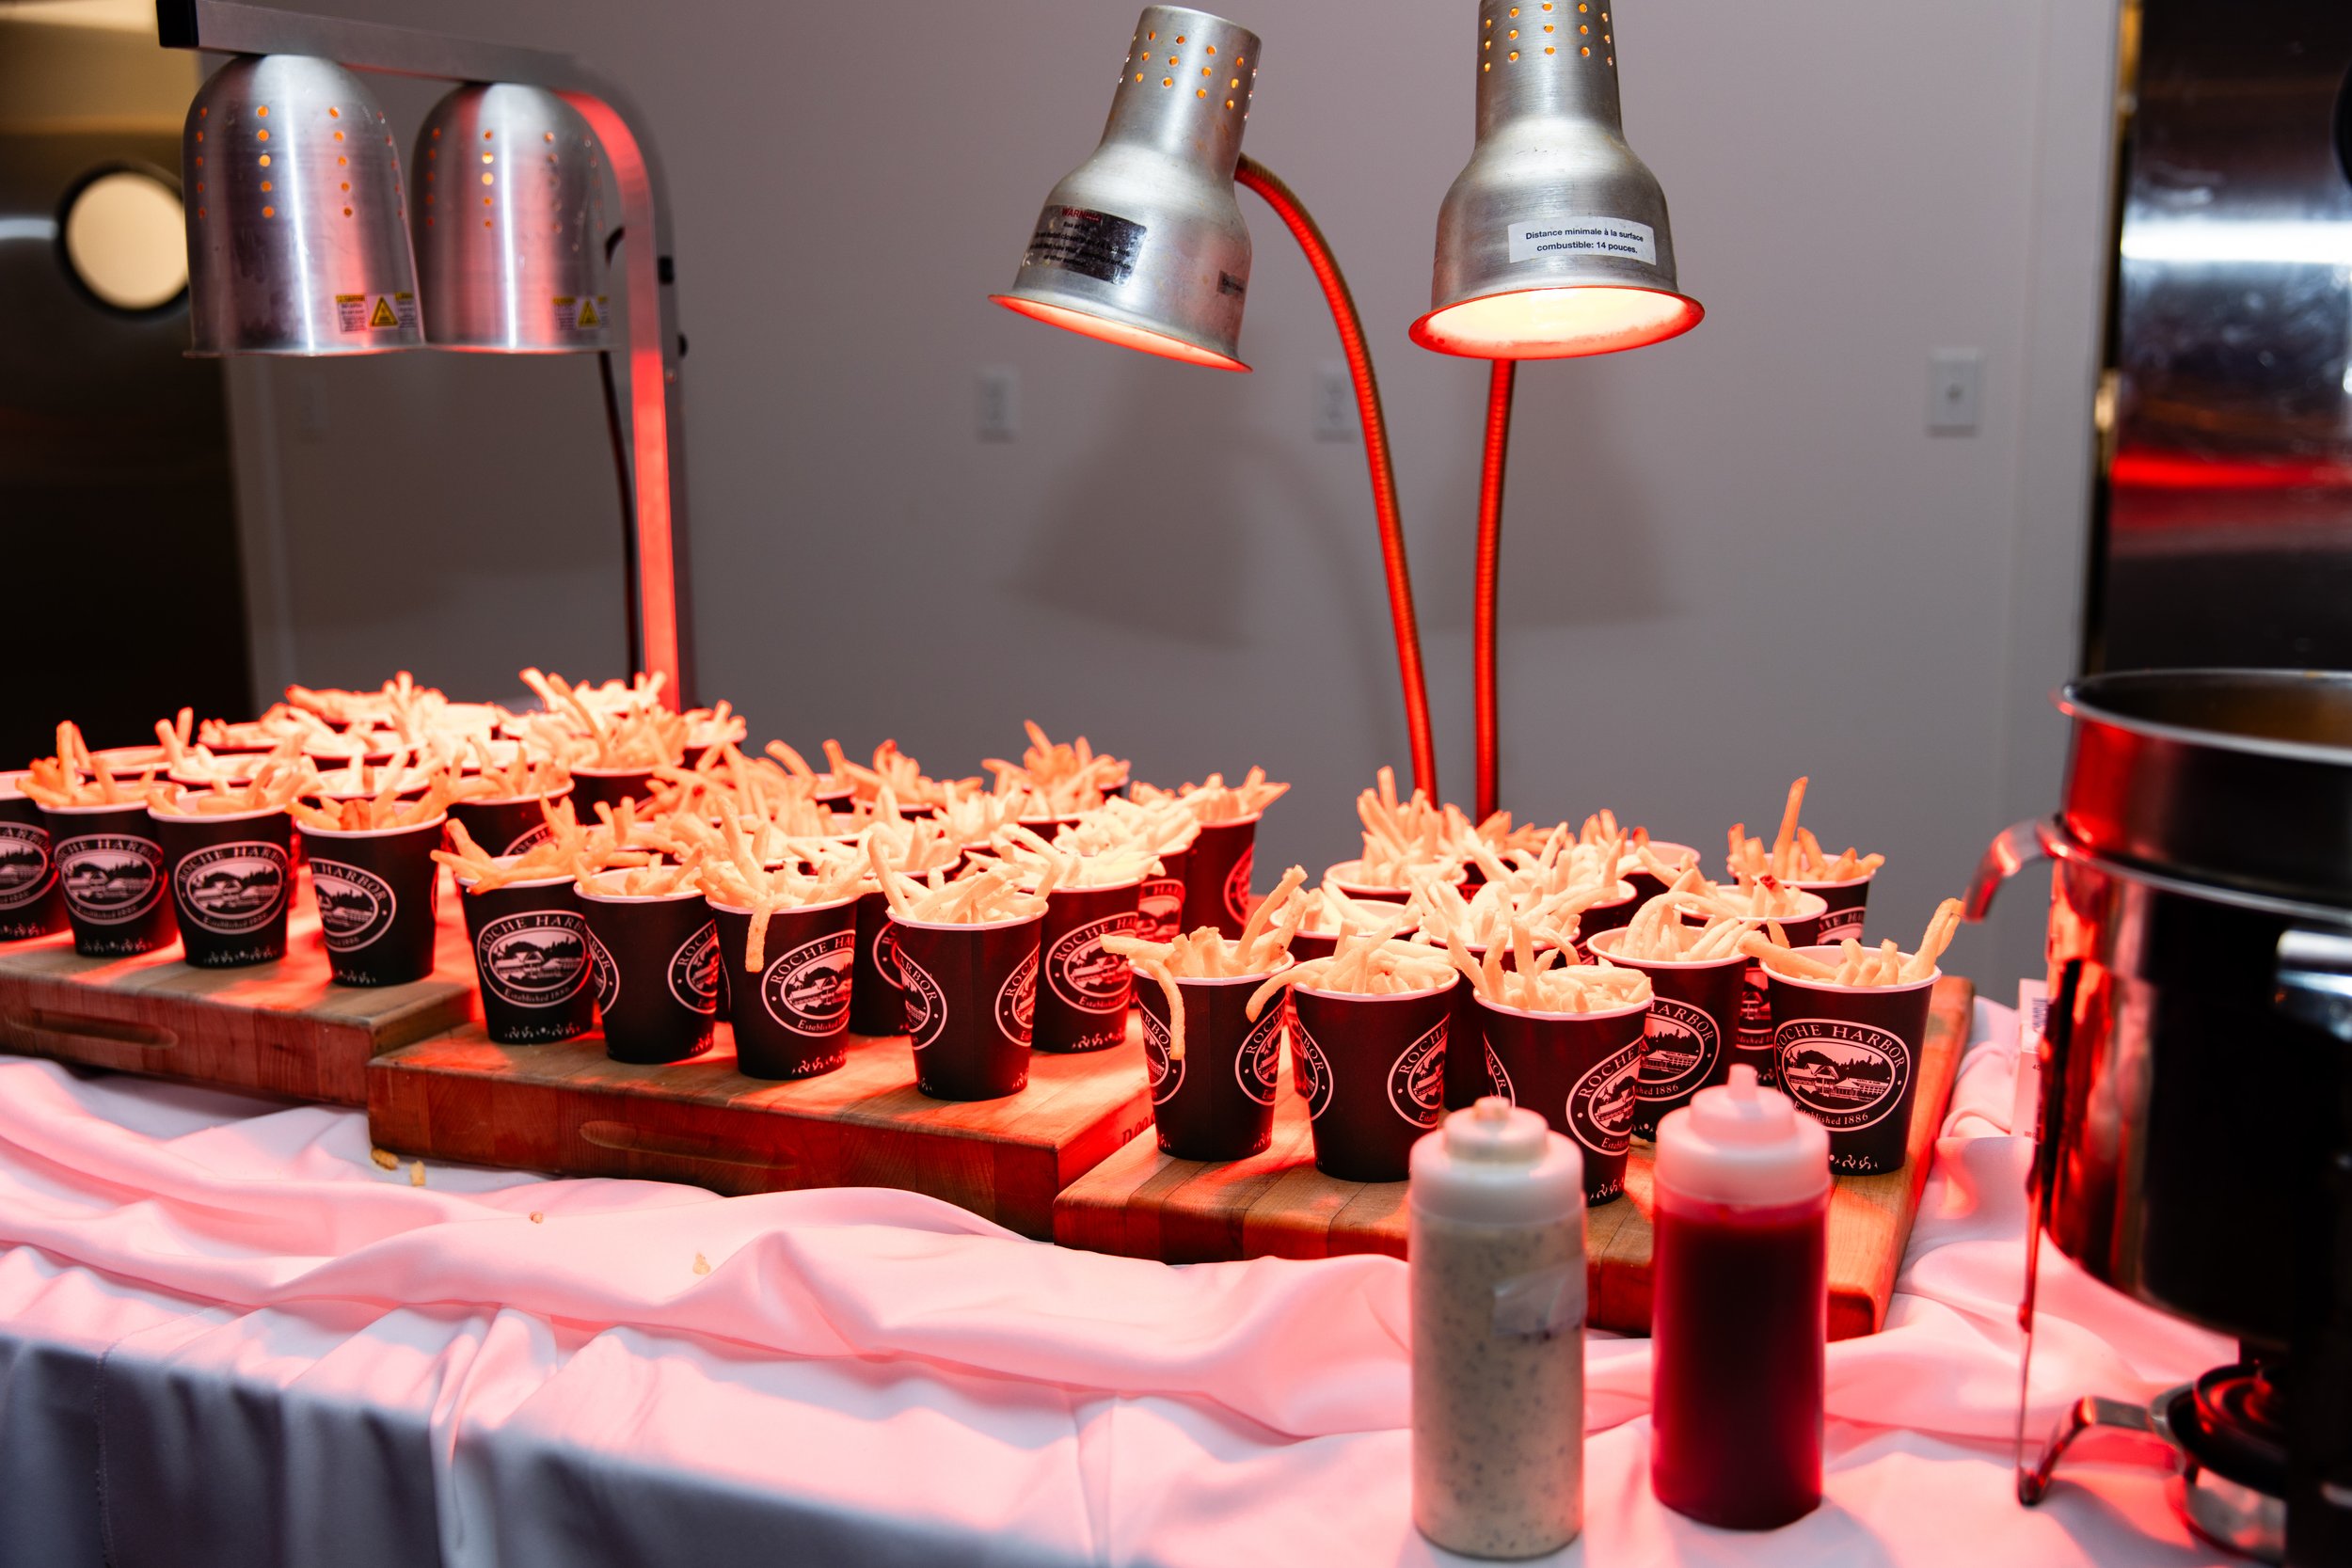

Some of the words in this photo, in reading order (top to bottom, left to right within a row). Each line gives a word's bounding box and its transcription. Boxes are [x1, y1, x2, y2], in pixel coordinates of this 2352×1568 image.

[1525, 230, 1563, 240] Distance
[1610, 229, 1617, 237] la
[1618, 230, 1644, 243] surface
[1536, 242, 1595, 252] combustible:
[1608, 244, 1638, 254] pouces.
[480, 918, 527, 953] ROCHE
[676, 927, 714, 967] ROCH
[1053, 922, 1110, 962] ROCHE
[770, 942, 829, 985] ROCHE
[1776, 1024, 1822, 1054] ROCHE
[1832, 1025, 1906, 1069] HARBOR
[1578, 1047, 1635, 1099] ROCHE
[1655, 1084, 1679, 1096] 1886
[1844, 1112, 1869, 1126] 1886
